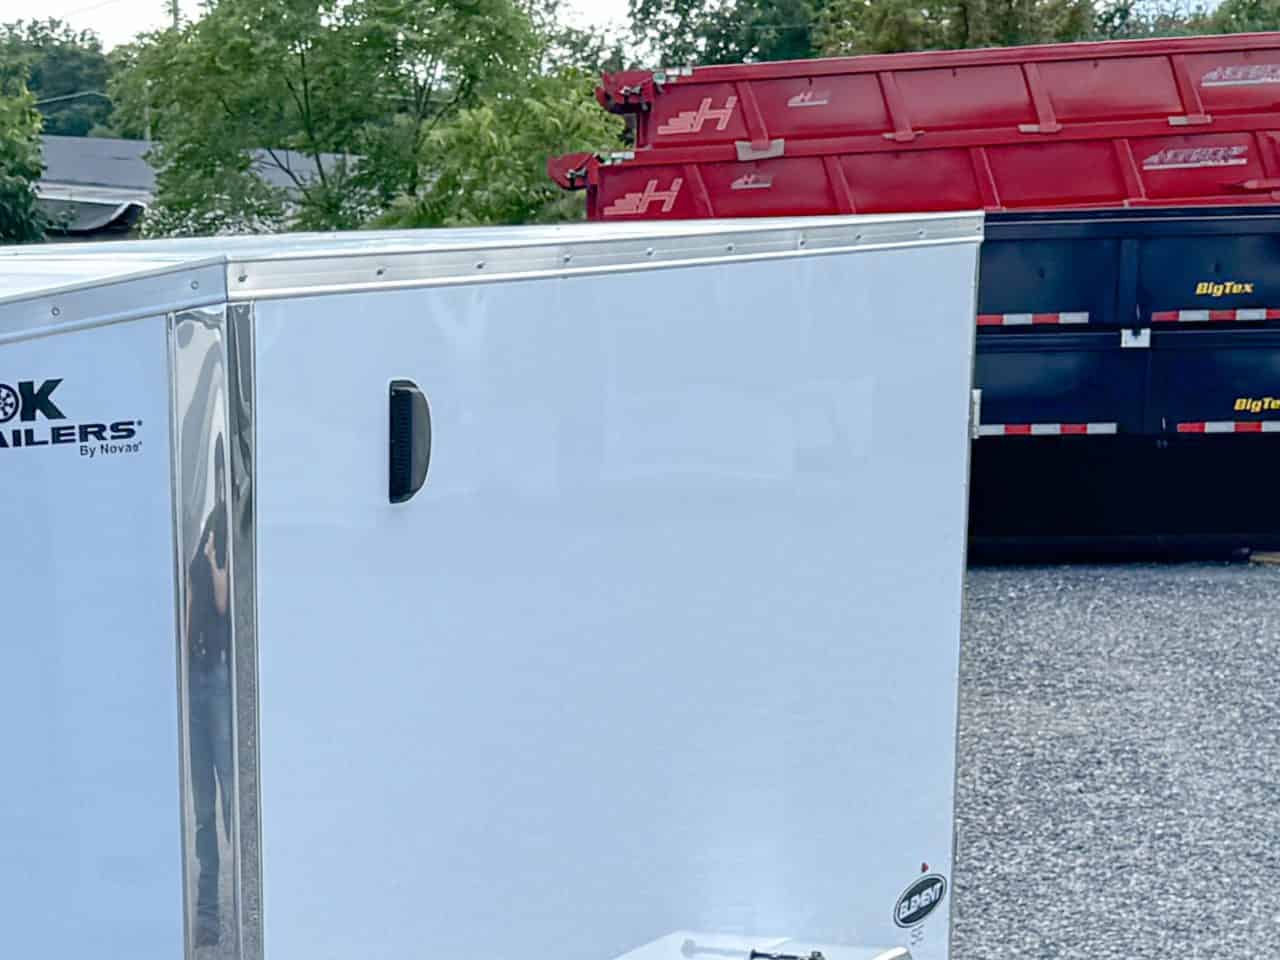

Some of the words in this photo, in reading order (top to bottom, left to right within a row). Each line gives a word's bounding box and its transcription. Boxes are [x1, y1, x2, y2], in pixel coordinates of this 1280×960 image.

[1195, 281, 1254, 297] BigTex
[1233, 397, 1280, 413] BigTe
[80, 445, 96, 458] By
